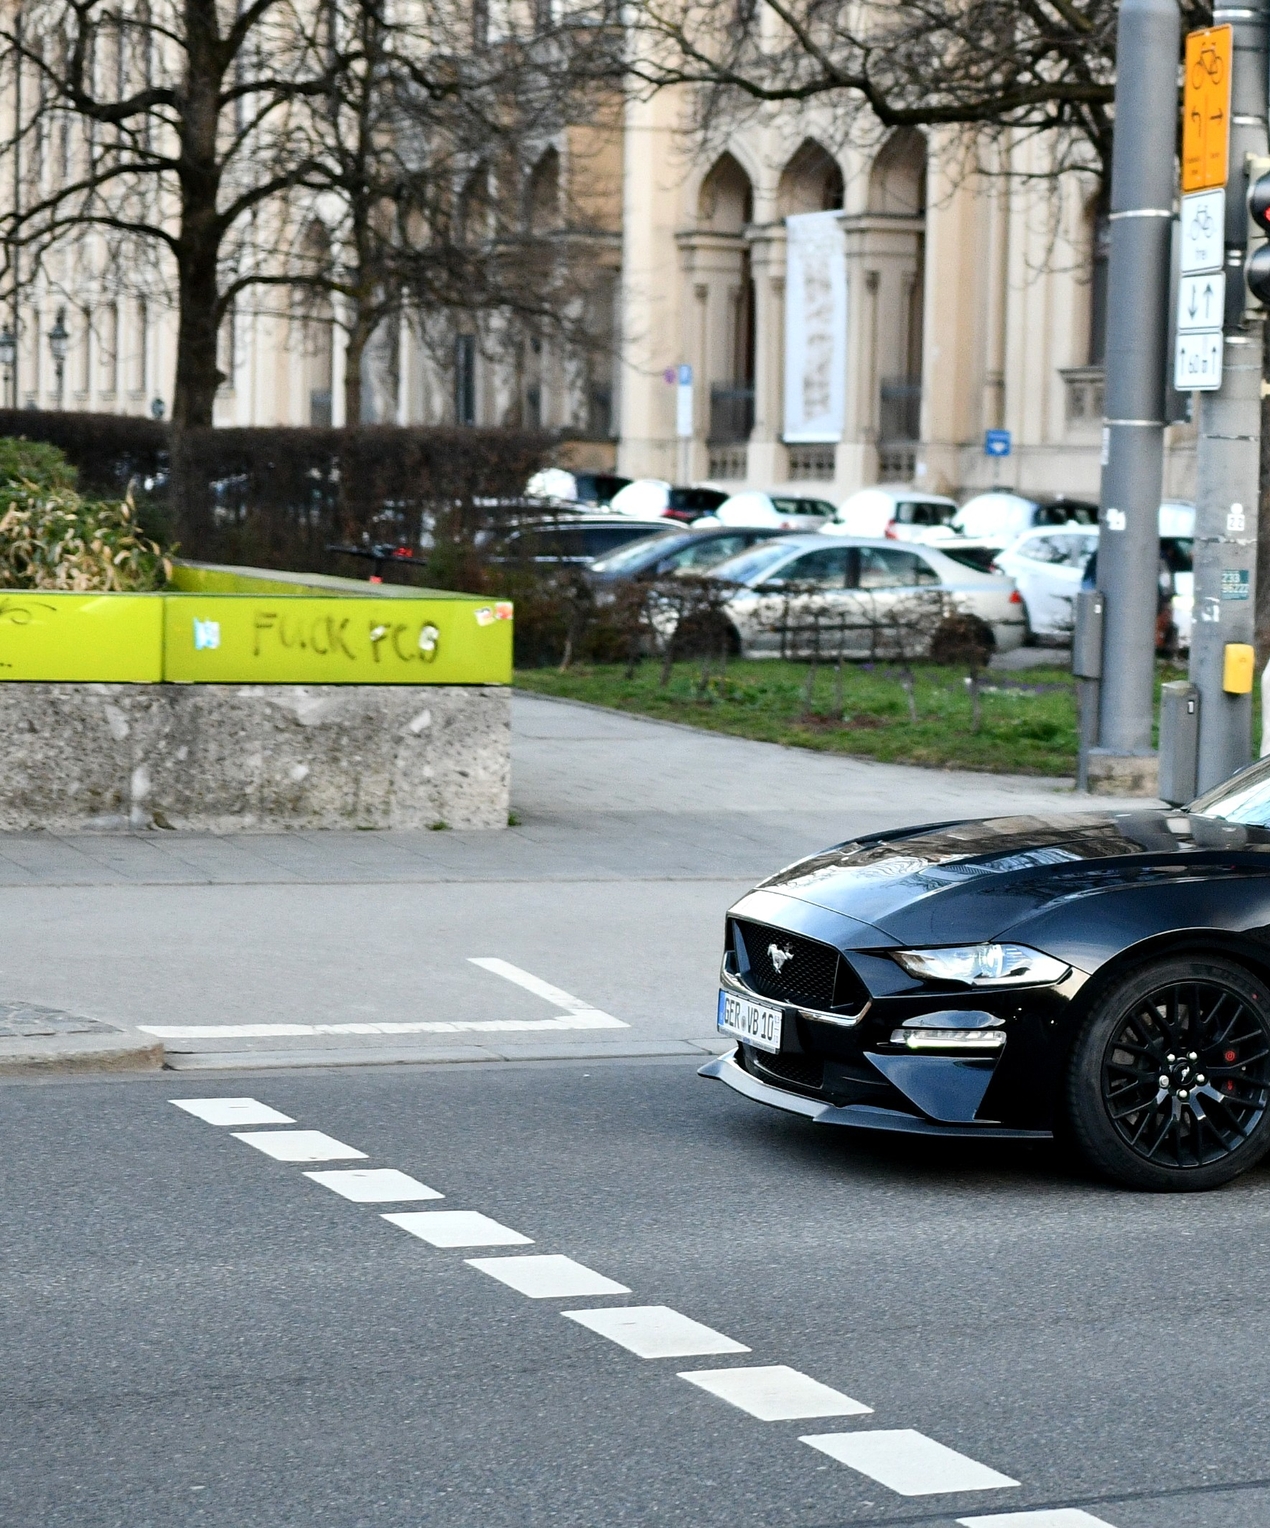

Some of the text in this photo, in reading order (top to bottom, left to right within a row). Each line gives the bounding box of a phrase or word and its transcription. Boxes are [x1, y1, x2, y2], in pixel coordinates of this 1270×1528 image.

[724, 997, 774, 1041] GER VB 10
